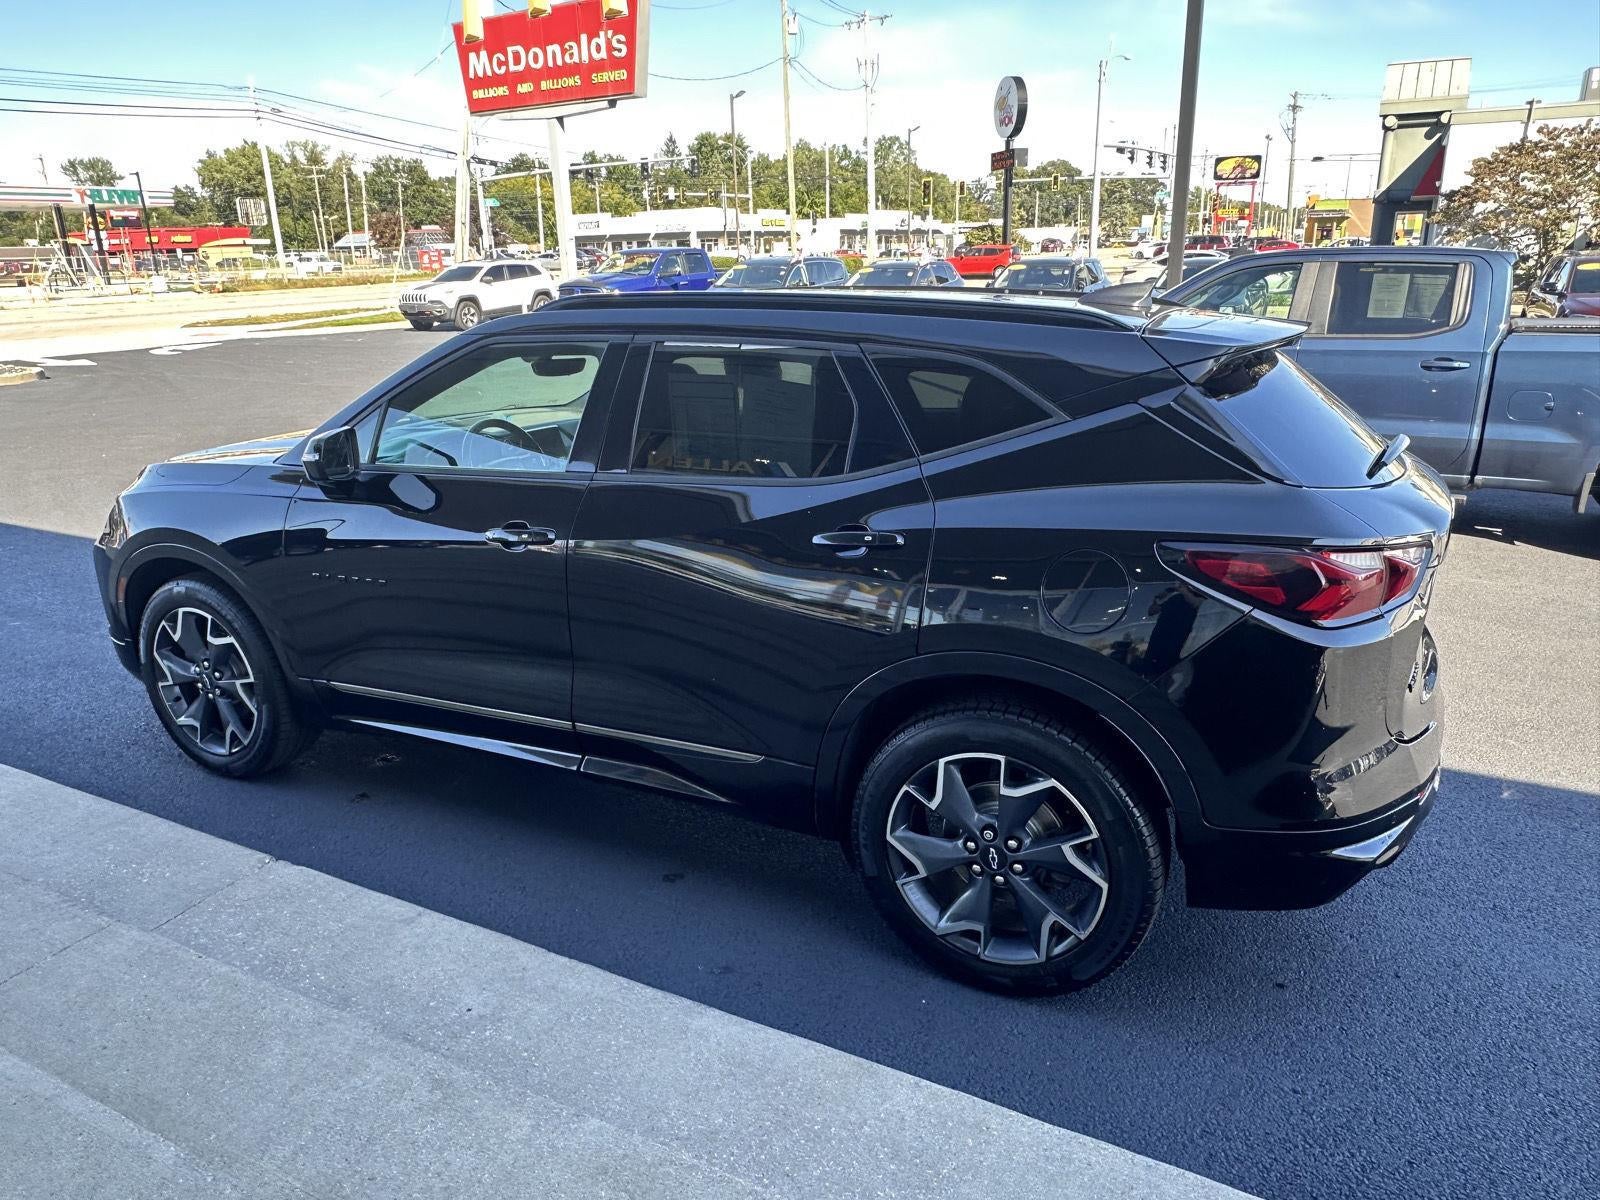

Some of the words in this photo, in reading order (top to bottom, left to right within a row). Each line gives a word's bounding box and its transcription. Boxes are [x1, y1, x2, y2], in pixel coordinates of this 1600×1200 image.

[468, 30, 628, 79] McDonald's
[472, 85, 509, 100] BILLIONS
[516, 82, 534, 95] AND
[540, 75, 581, 91] BILLIONS
[591, 69, 628, 84] SERVED
